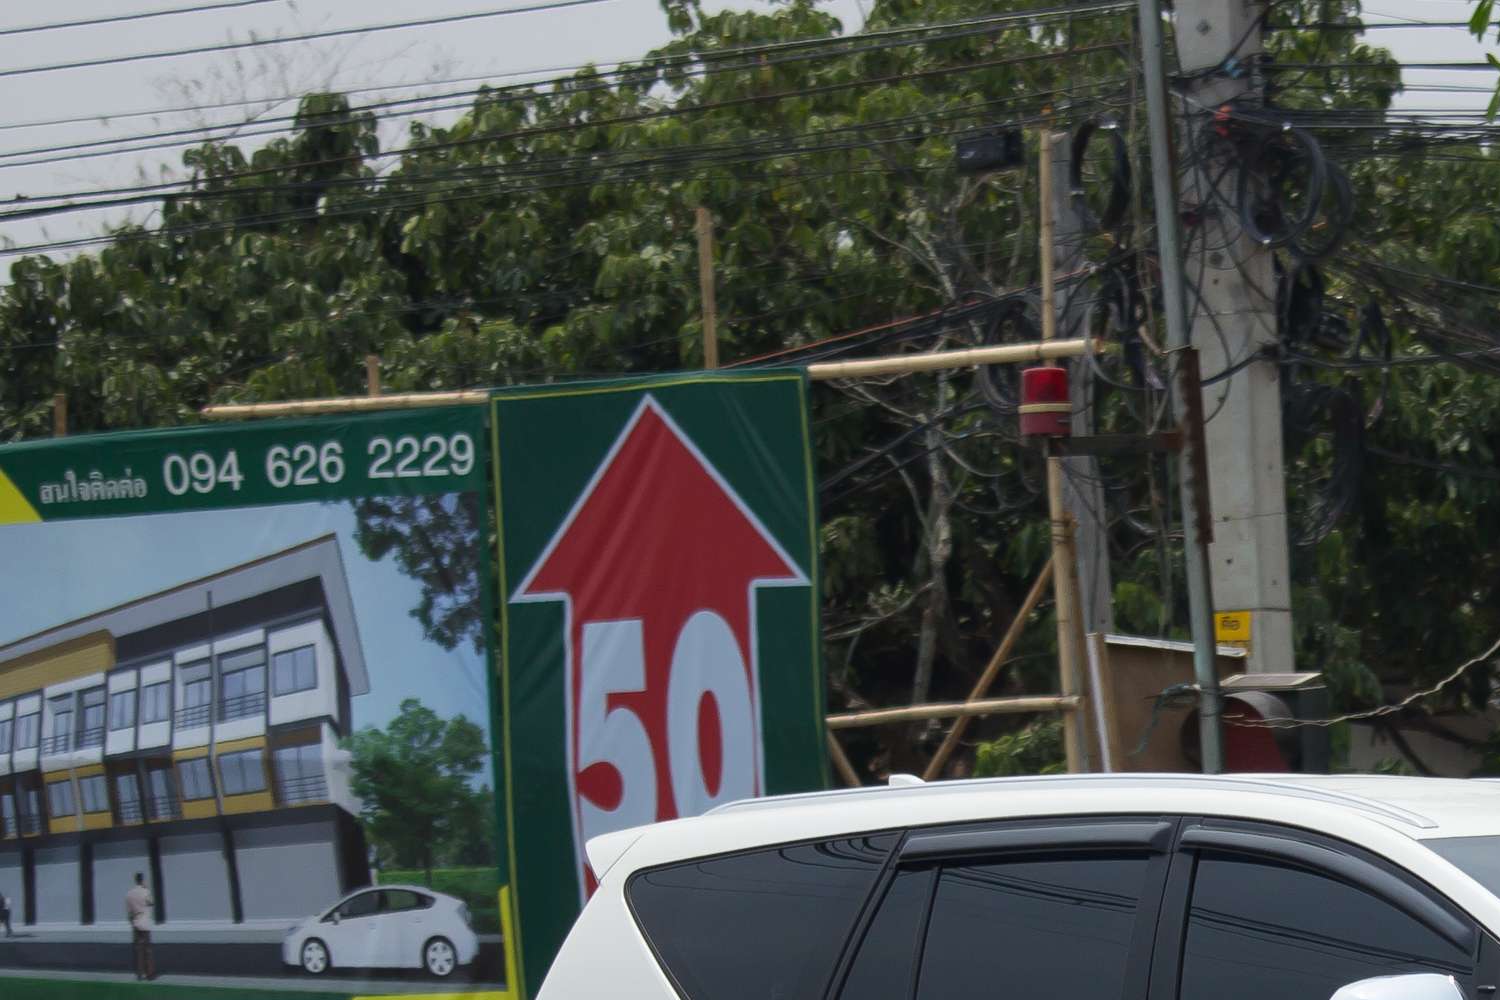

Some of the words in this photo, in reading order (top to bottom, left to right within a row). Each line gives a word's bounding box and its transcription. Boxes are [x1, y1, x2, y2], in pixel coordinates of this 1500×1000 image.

[40, 467, 148, 504] สนใจติดต่อ
[163, 450, 244, 496] 094
[265, 441, 346, 488] 626
[367, 433, 475, 479] 2229
[577, 610, 758, 838] 50
